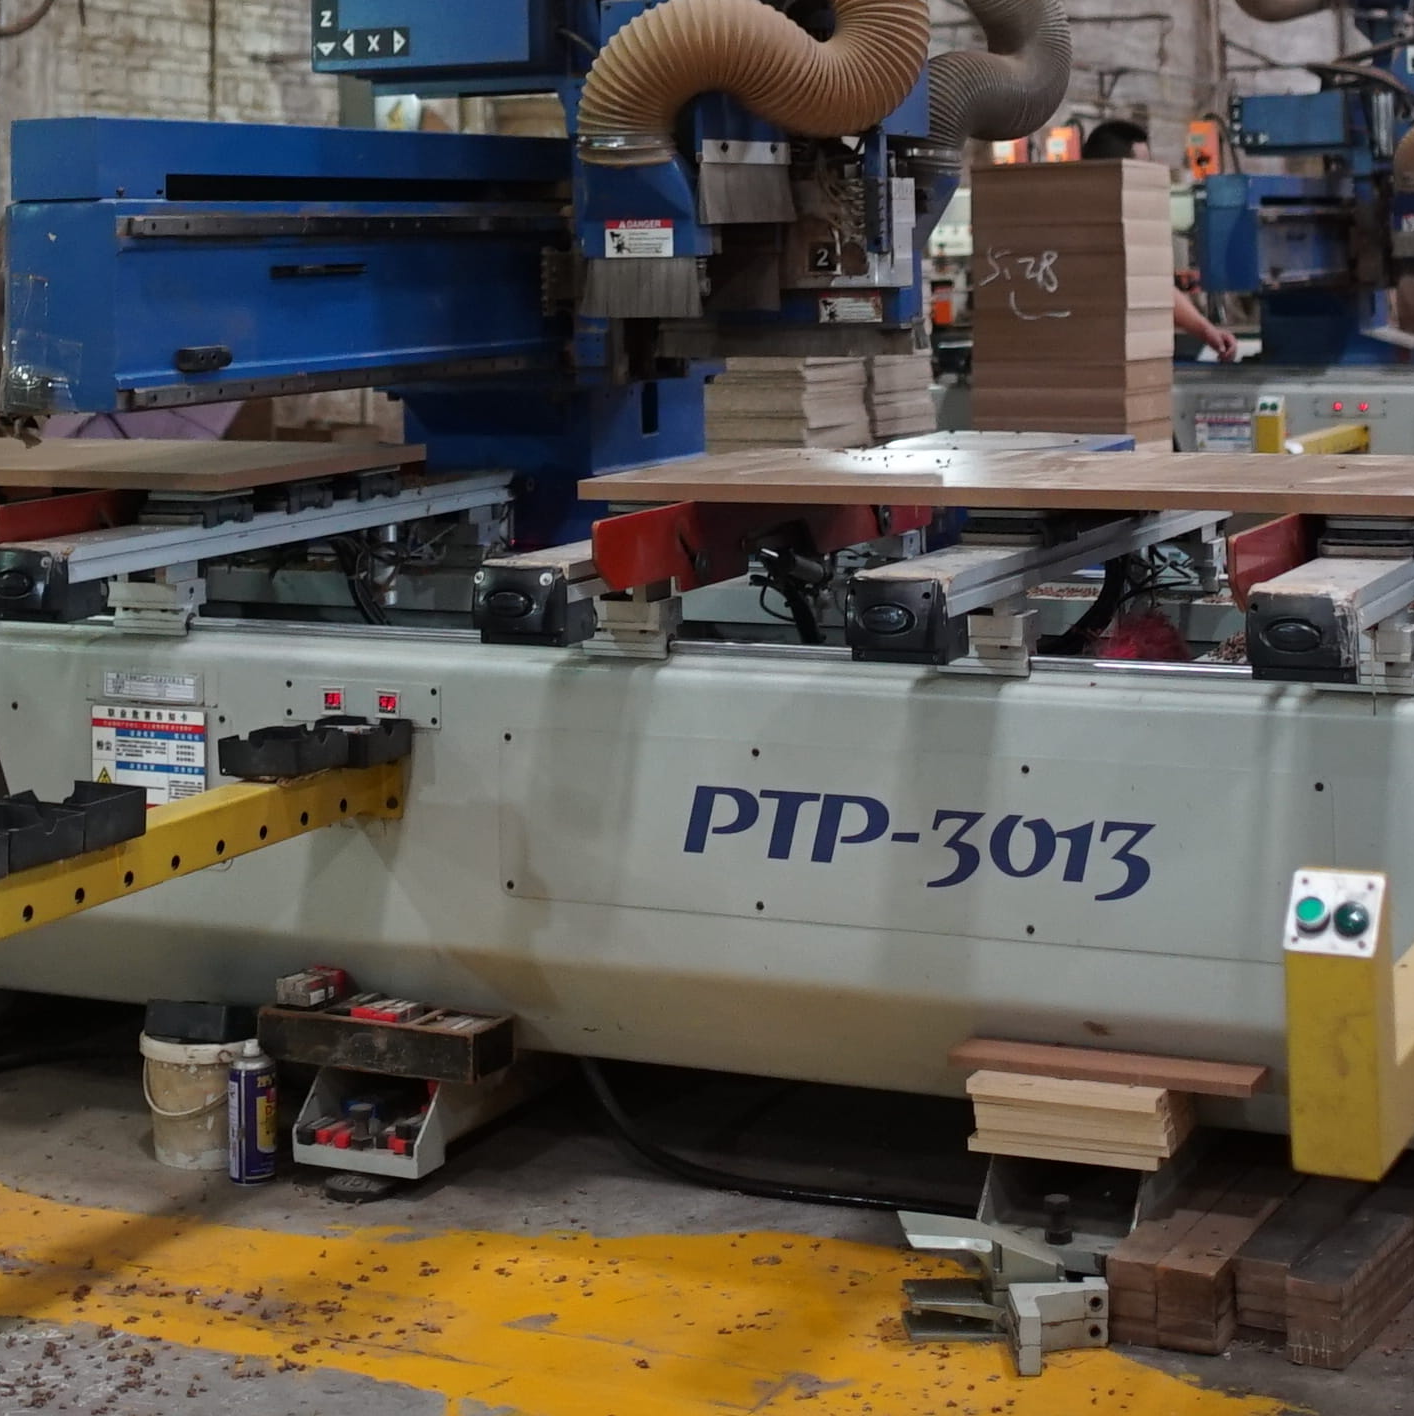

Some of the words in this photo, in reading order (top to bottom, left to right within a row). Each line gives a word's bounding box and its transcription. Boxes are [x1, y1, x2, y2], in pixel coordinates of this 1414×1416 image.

[320, 9, 332, 28] Z
[367, 34, 380, 52] X
[627, 219, 661, 229] DANGER
[816, 248, 829, 266] 2
[683, 785, 1156, 902] PTP-3013
